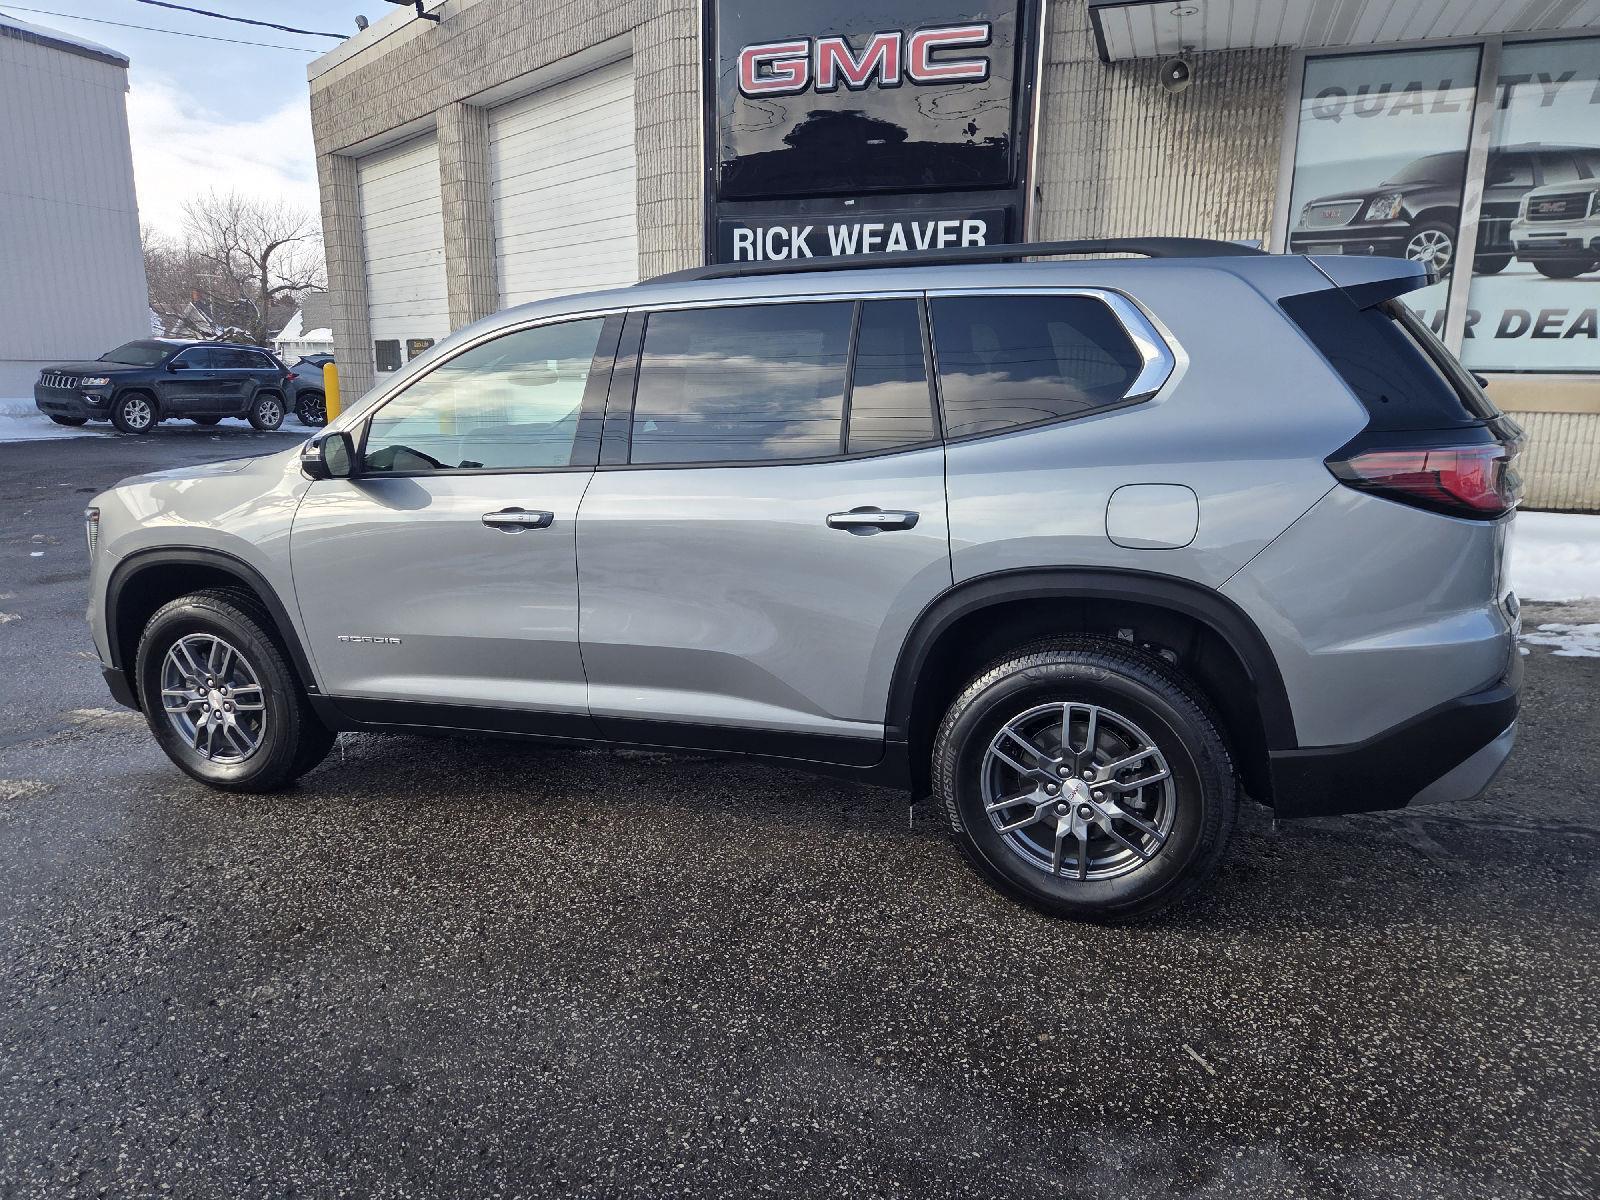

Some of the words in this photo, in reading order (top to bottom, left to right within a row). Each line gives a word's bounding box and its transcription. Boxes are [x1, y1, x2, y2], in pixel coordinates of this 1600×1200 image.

[738, 21, 992, 98] GMC
[1312, 70, 1578, 124] QUALTY
[733, 225, 814, 261] RICK
[827, 219, 987, 257] WEAVER
